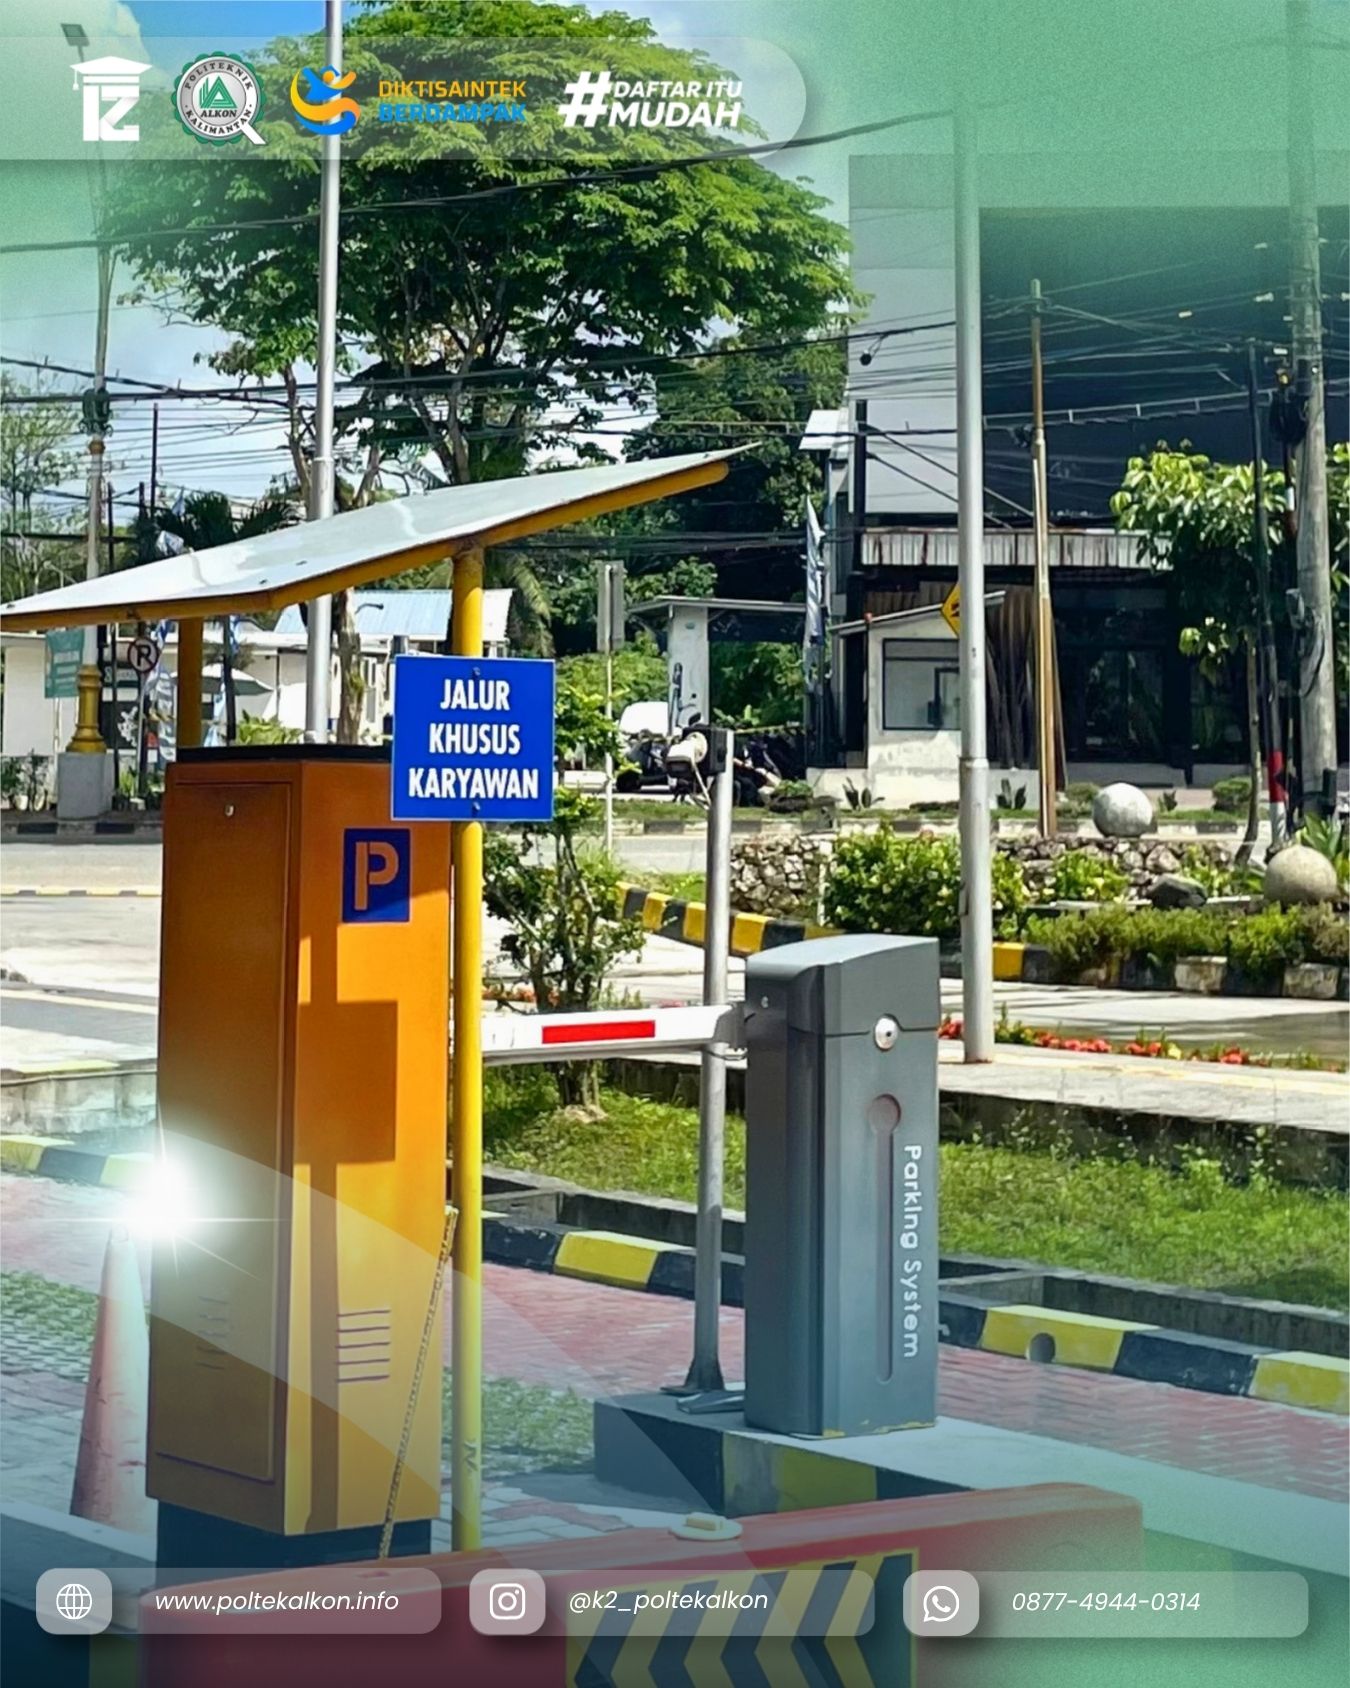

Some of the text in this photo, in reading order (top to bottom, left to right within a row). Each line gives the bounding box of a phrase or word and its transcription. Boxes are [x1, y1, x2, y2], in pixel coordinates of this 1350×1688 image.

[440, 678, 511, 711] JALUR
[428, 722, 522, 755] KHUSUS
[408, 767, 539, 799] KARYAWAN
[354, 841, 399, 911] P
[900, 1144, 922, 1358] Parking System
